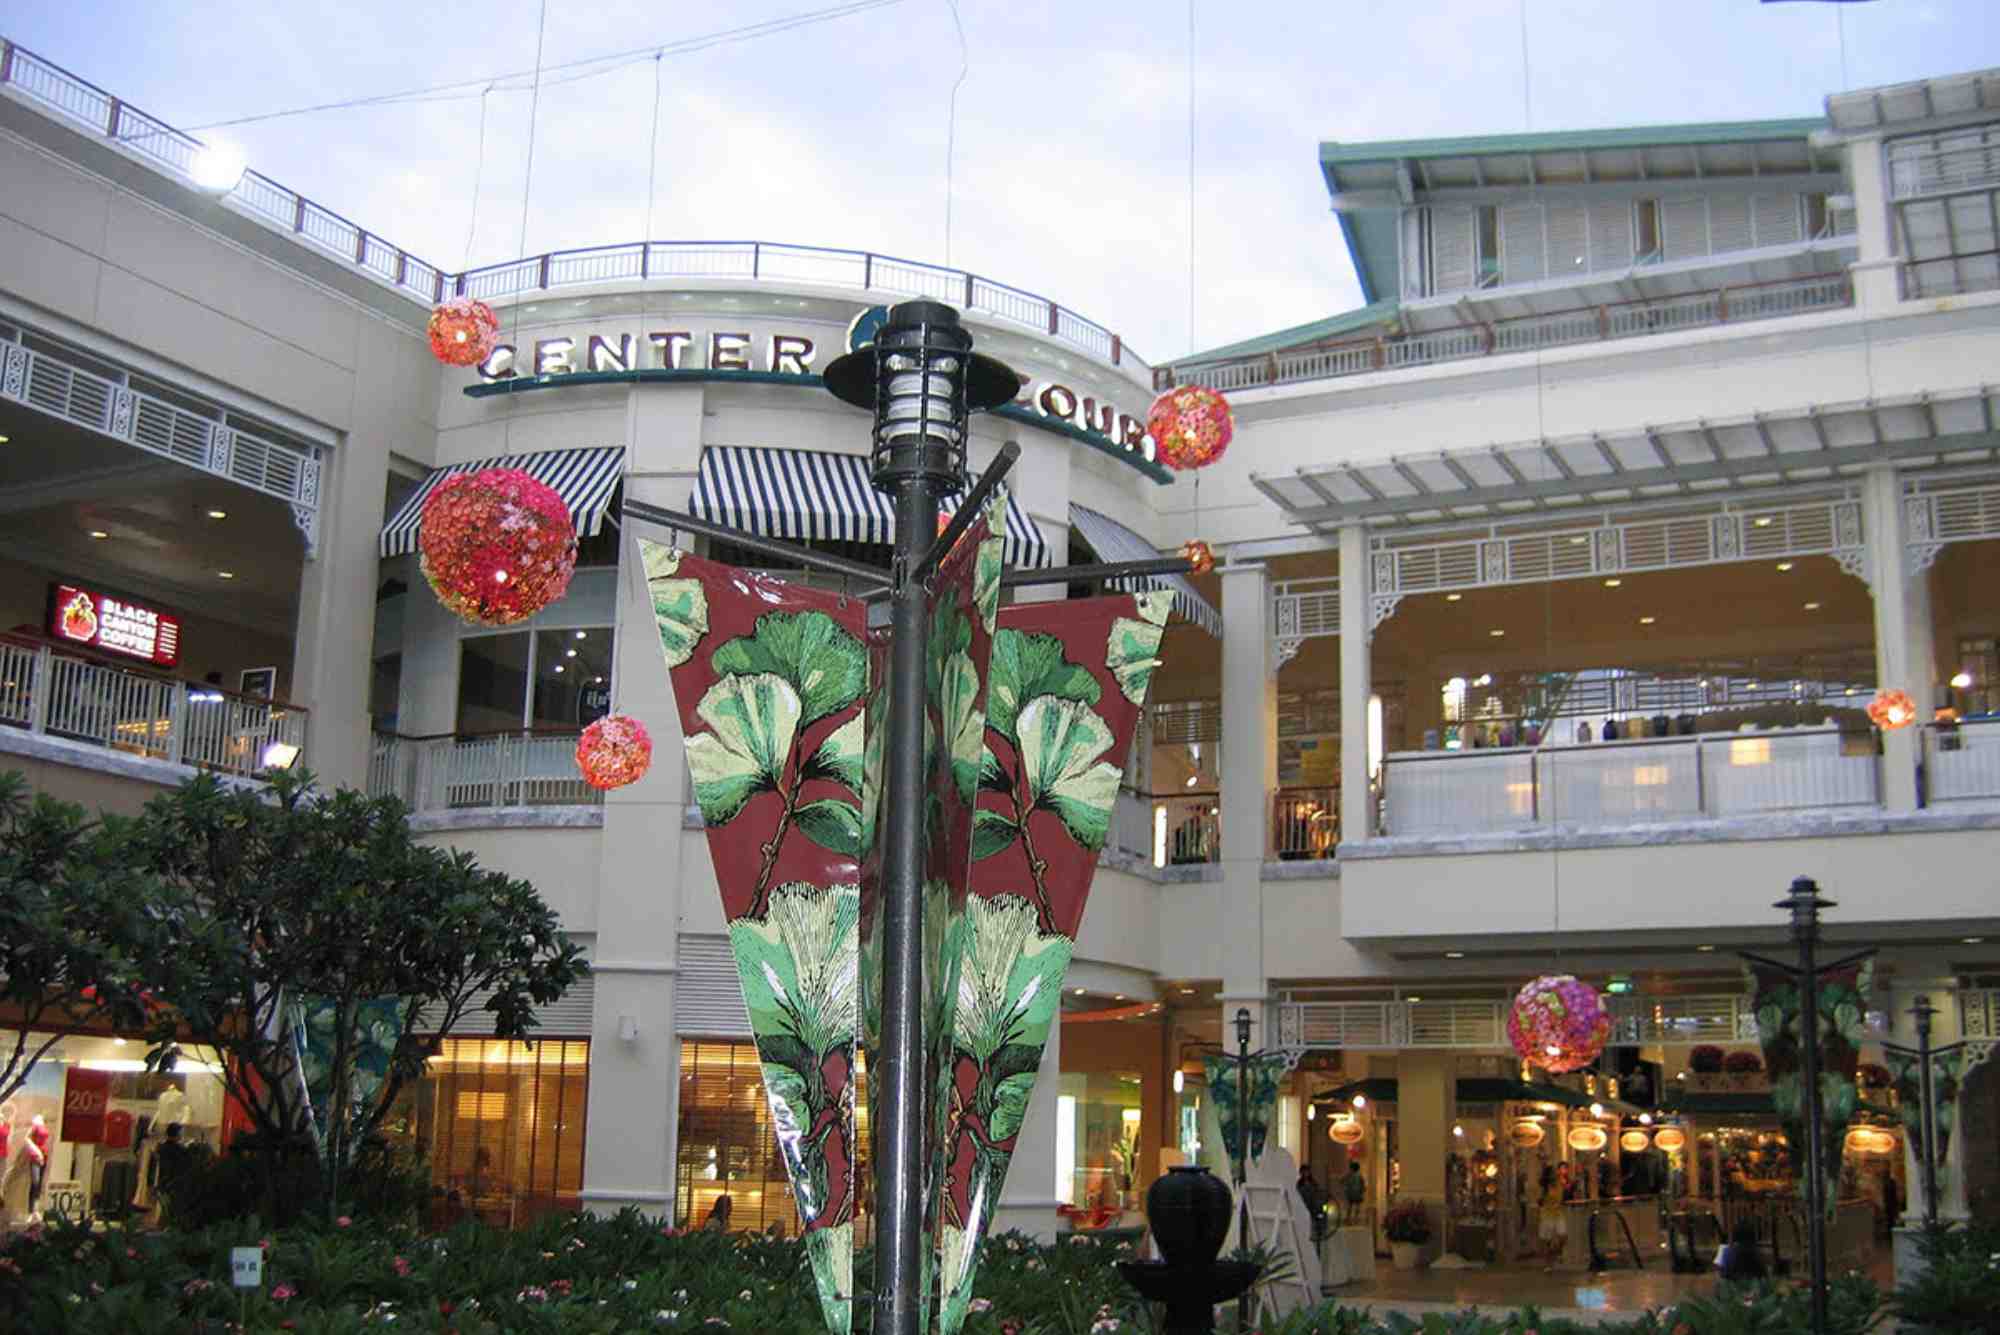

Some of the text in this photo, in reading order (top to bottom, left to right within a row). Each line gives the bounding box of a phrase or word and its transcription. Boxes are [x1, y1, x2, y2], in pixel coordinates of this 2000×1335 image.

[478, 332, 1157, 462] CENTER OUR
[102, 598, 159, 626] BLACK
[99, 627, 155, 654] COFFEE
